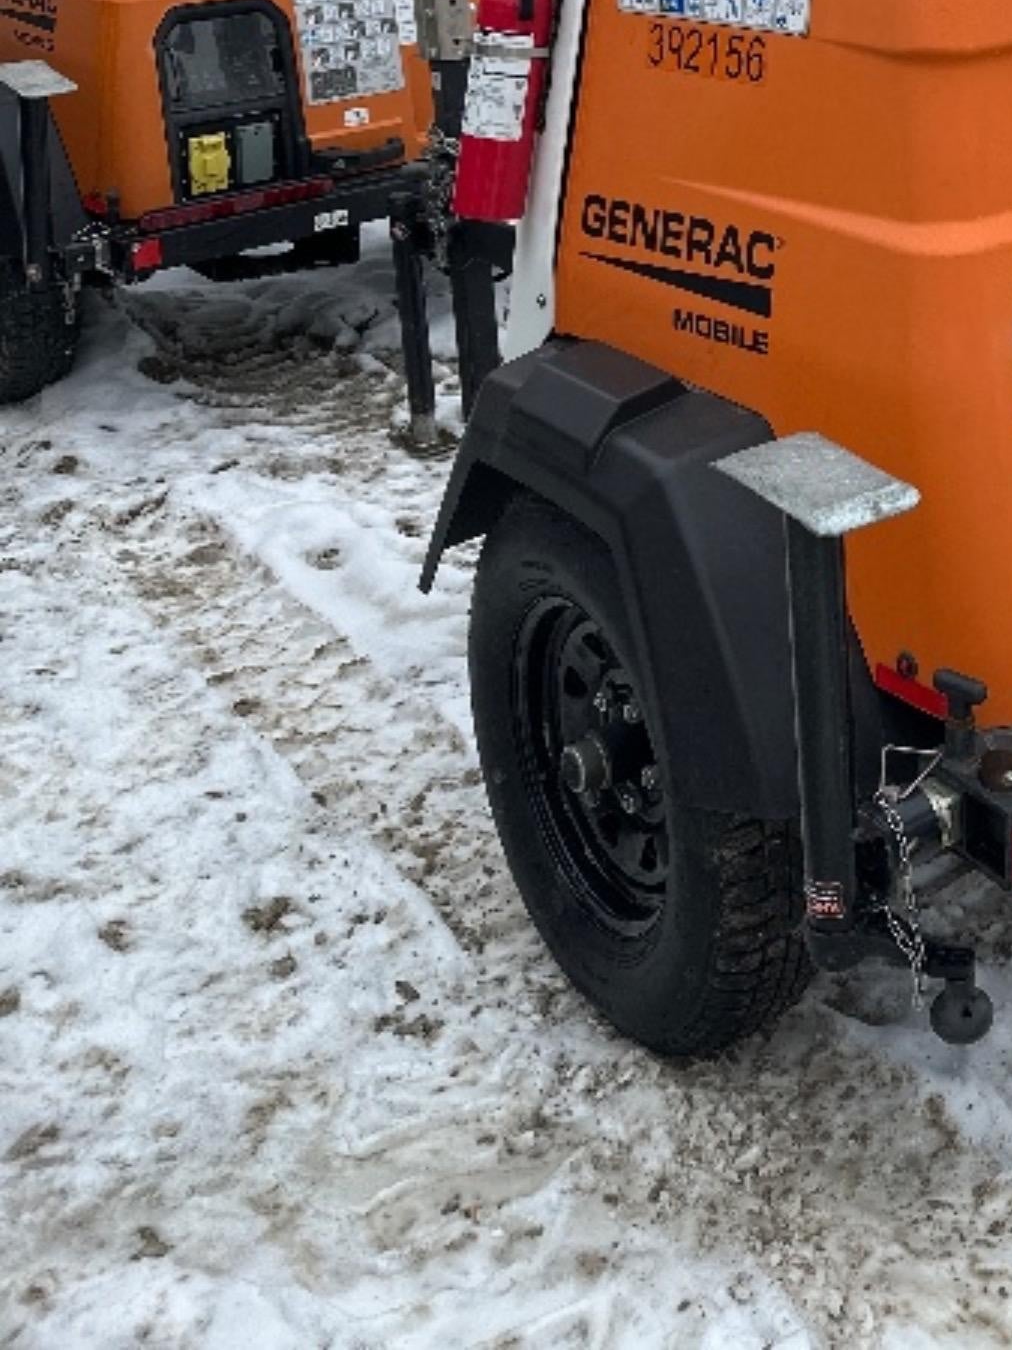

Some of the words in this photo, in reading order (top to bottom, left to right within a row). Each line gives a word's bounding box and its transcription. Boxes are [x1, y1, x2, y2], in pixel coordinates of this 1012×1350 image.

[647, 23, 766, 82] 392156
[581, 194, 775, 280] GENERAC
[671, 308, 769, 355] MOBILE
